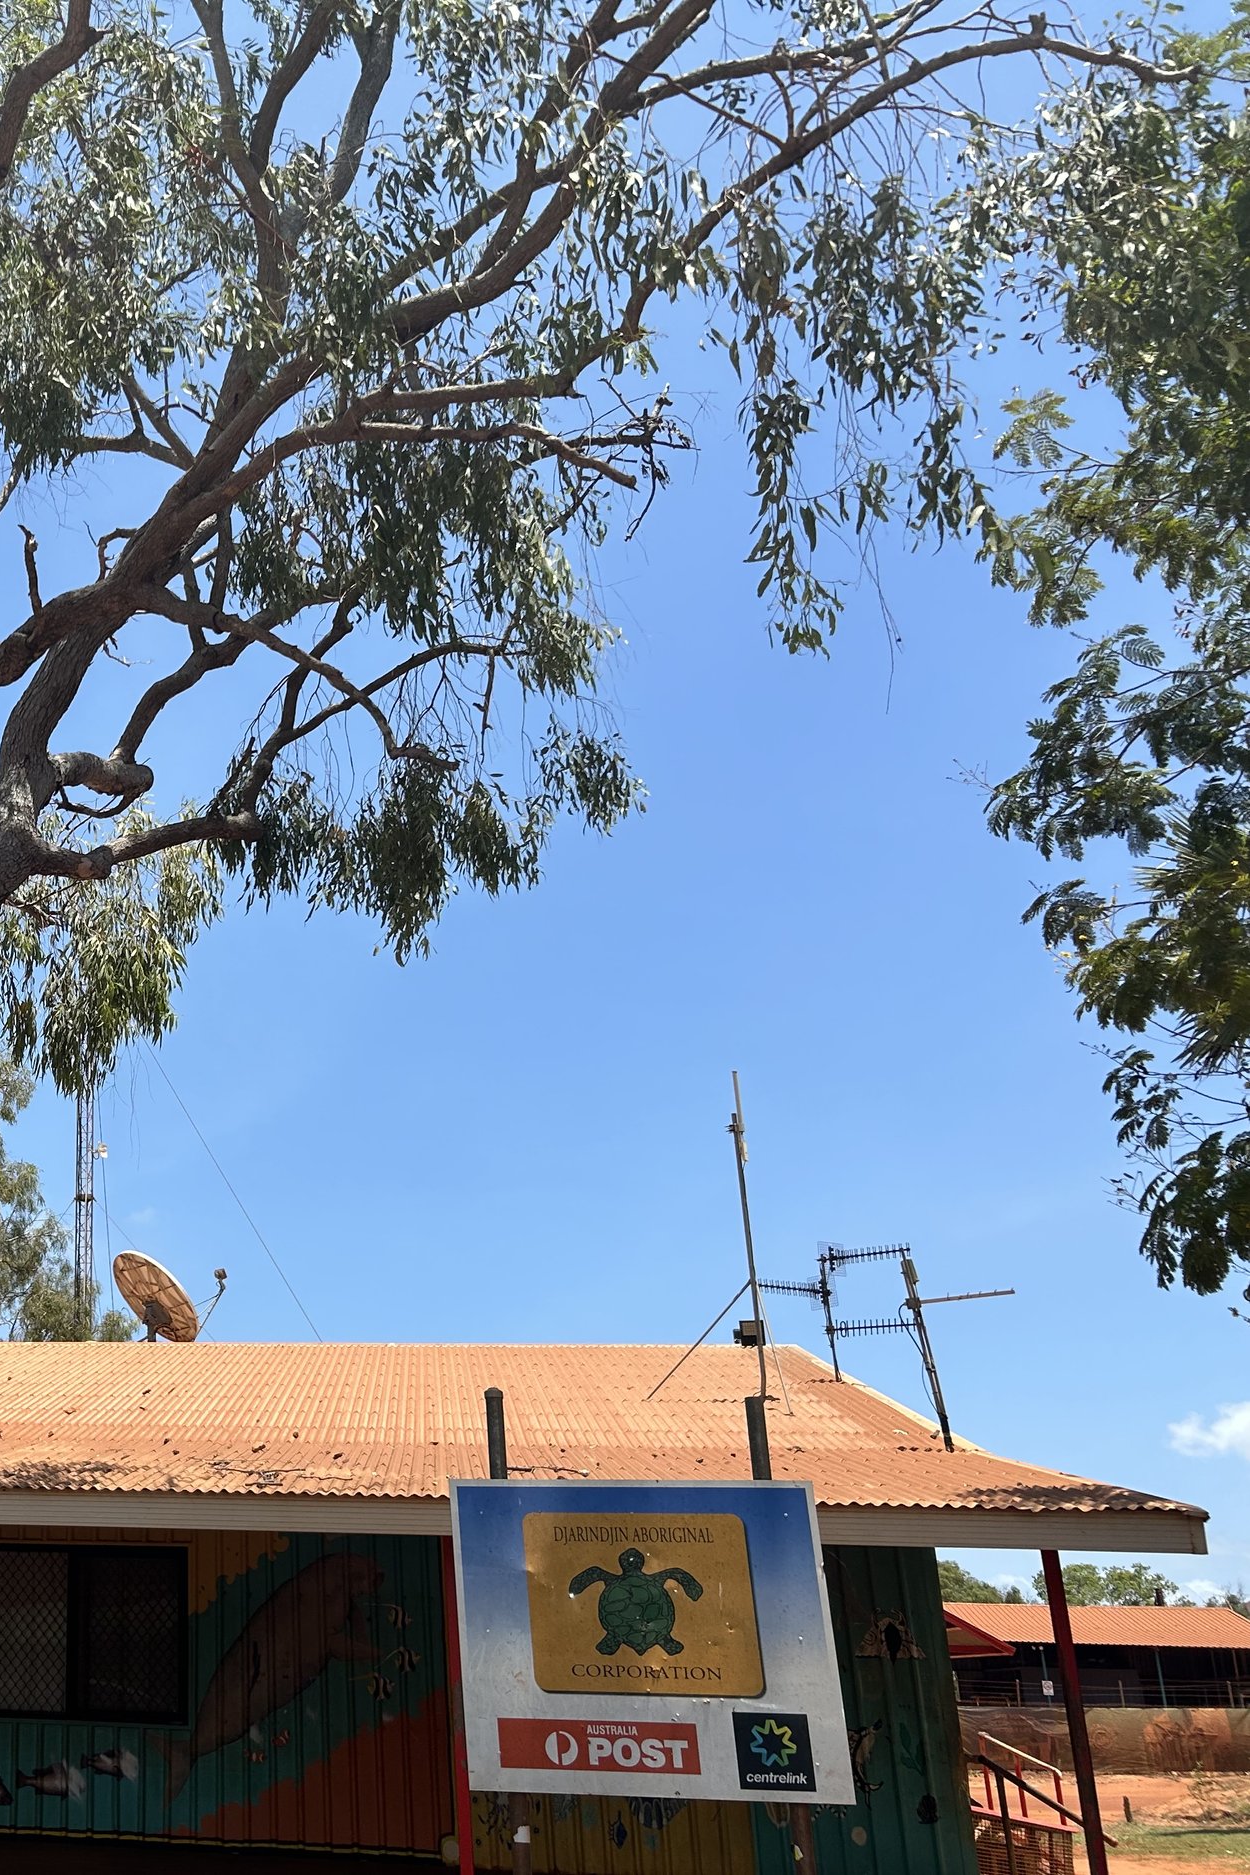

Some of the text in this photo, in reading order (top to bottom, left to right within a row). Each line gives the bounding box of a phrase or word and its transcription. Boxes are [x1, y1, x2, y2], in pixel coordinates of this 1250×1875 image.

[553, 1526, 714, 1544] DJARINDJIN ABORIGINAL
[571, 1663, 722, 1681] CORPORATION
[586, 1724, 638, 1736] AUSTRALIA
[588, 1738, 688, 1770] POST
[746, 1771, 808, 1785] centrelink
